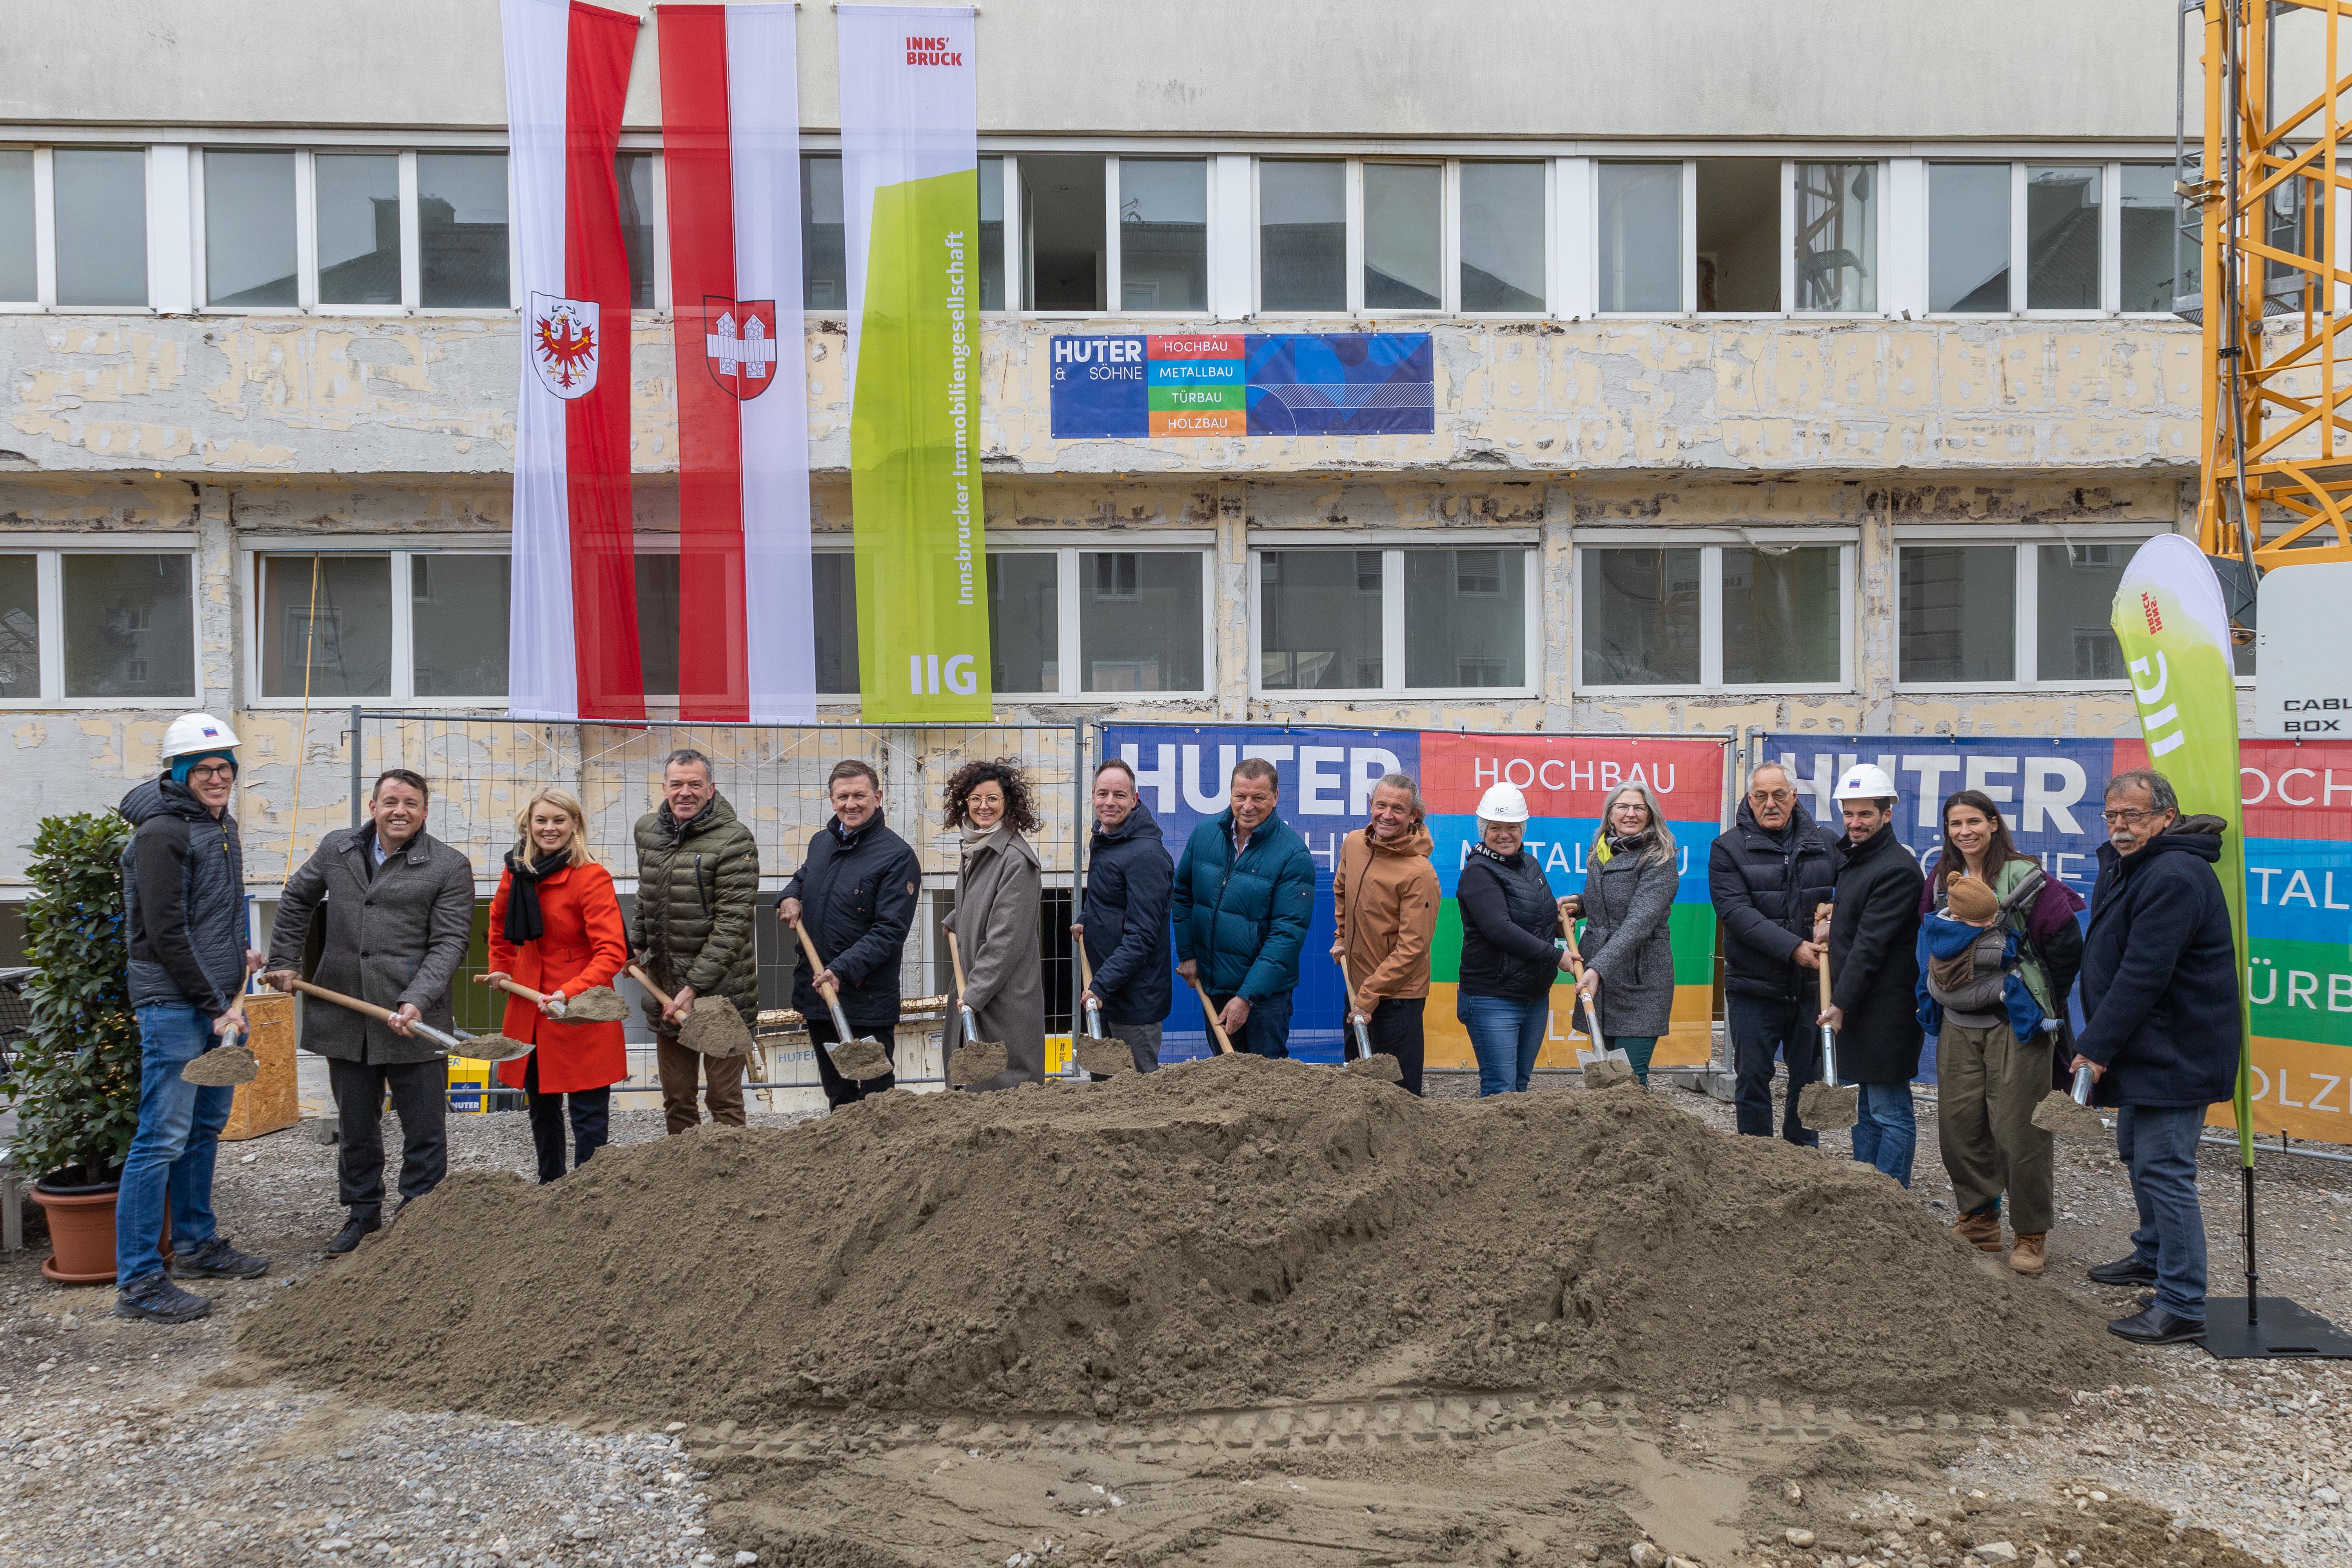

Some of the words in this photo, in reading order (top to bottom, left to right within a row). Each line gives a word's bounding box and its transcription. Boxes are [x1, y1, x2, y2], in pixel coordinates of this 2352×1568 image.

[906, 36, 950, 51] INNS'
[906, 52, 962, 67] BRUCK
[945, 230, 971, 477] Immobiliengesellschaft
[1055, 340, 1142, 363] HUTER
[1163, 341, 1228, 353] HOCHBAU
[1055, 368, 1065, 380] &
[1089, 365, 1142, 380] SÖHNE
[1159, 367, 1234, 378] METALLBAU
[1171, 390, 1222, 404] TÜRBAU
[1167, 418, 1228, 429] HOLZBAU
[952, 482, 974, 605] Innsbrucker
[910, 654, 976, 695] IIG
[2284, 719, 2340, 732] BOX
[1475, 757, 1675, 793] HOCHBAU
